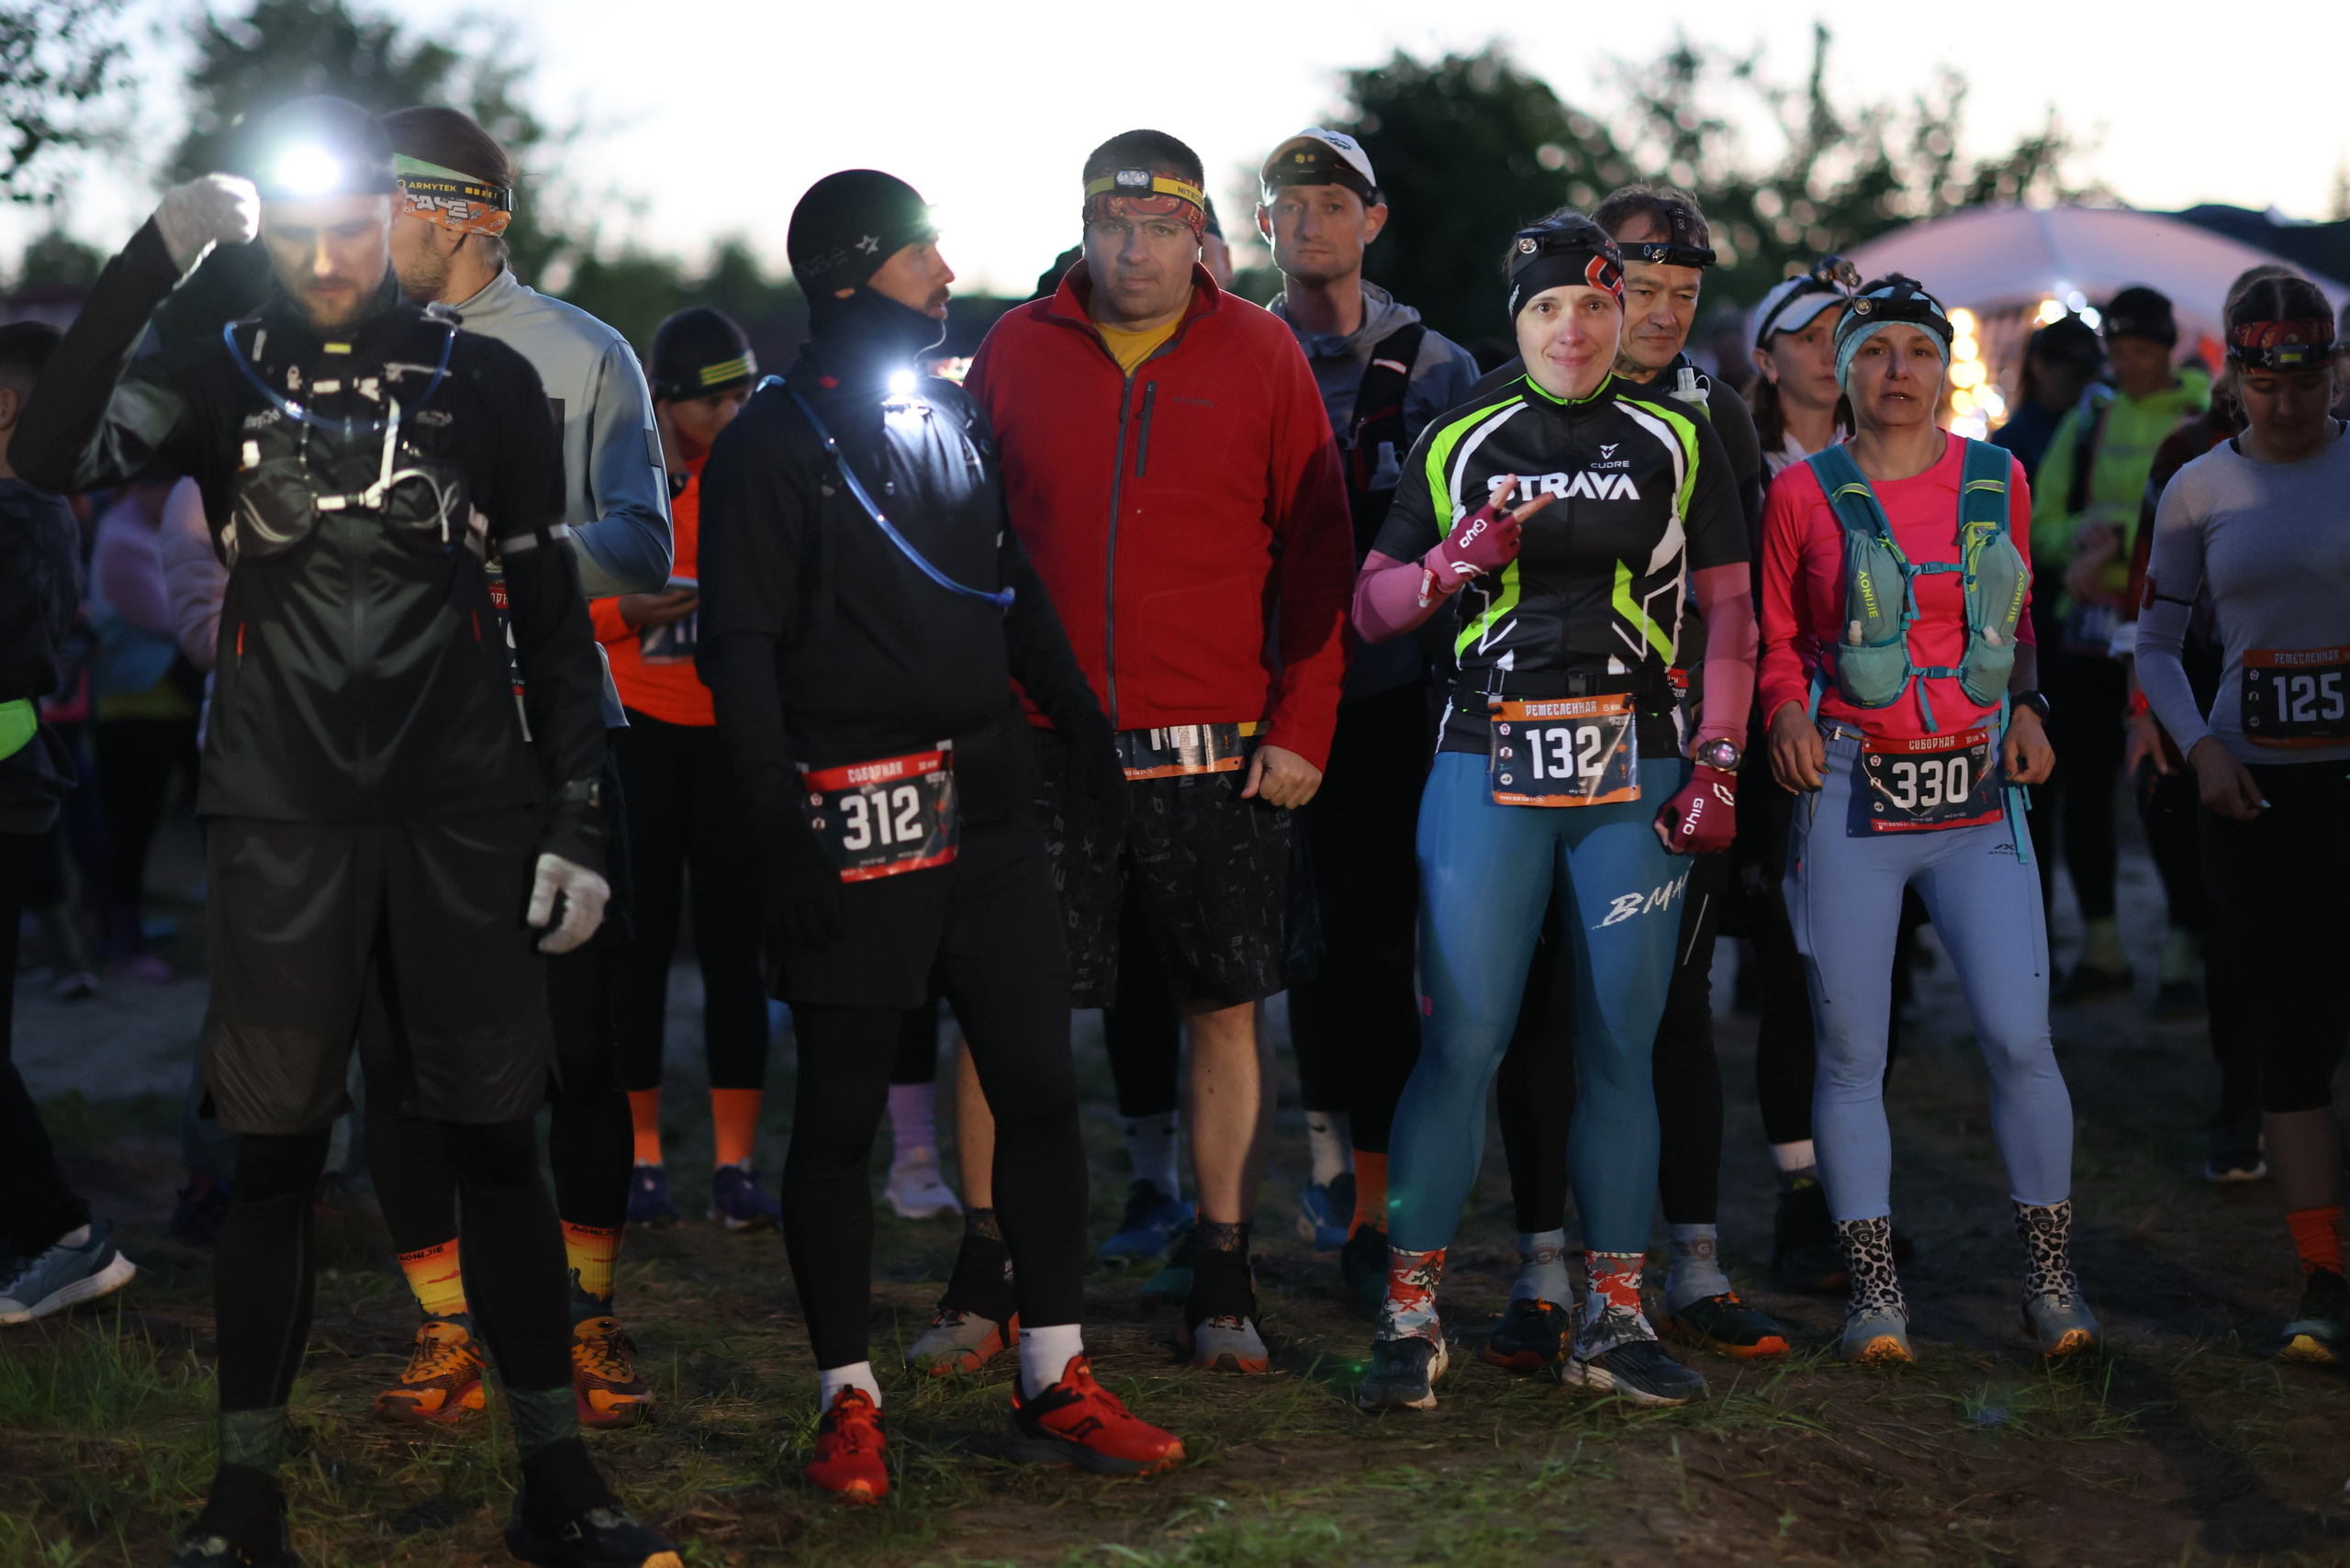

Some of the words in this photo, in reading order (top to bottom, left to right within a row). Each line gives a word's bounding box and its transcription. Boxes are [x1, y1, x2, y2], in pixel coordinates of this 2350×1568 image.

[408, 182, 456, 192] ARMYTEK
[1591, 460, 1630, 469] CUDRE
[1487, 470, 1640, 501] STRAVA
[1858, 570, 1879, 619] AONIJIE
[2007, 571, 2026, 623] AONIJIE
[1525, 700, 1597, 717] РЕМЕСЛЕННАЯ
[1602, 704, 1610, 712] 15
[2273, 672, 2344, 722] 125
[1526, 726, 1603, 779] 132
[1908, 735, 1955, 751] СОБОРНАЯ
[847, 761, 902, 783] СОБОРНАЯ
[1892, 756, 1969, 809] 330
[840, 785, 923, 851] 312
[399, 1246, 443, 1260] AONIJIE
